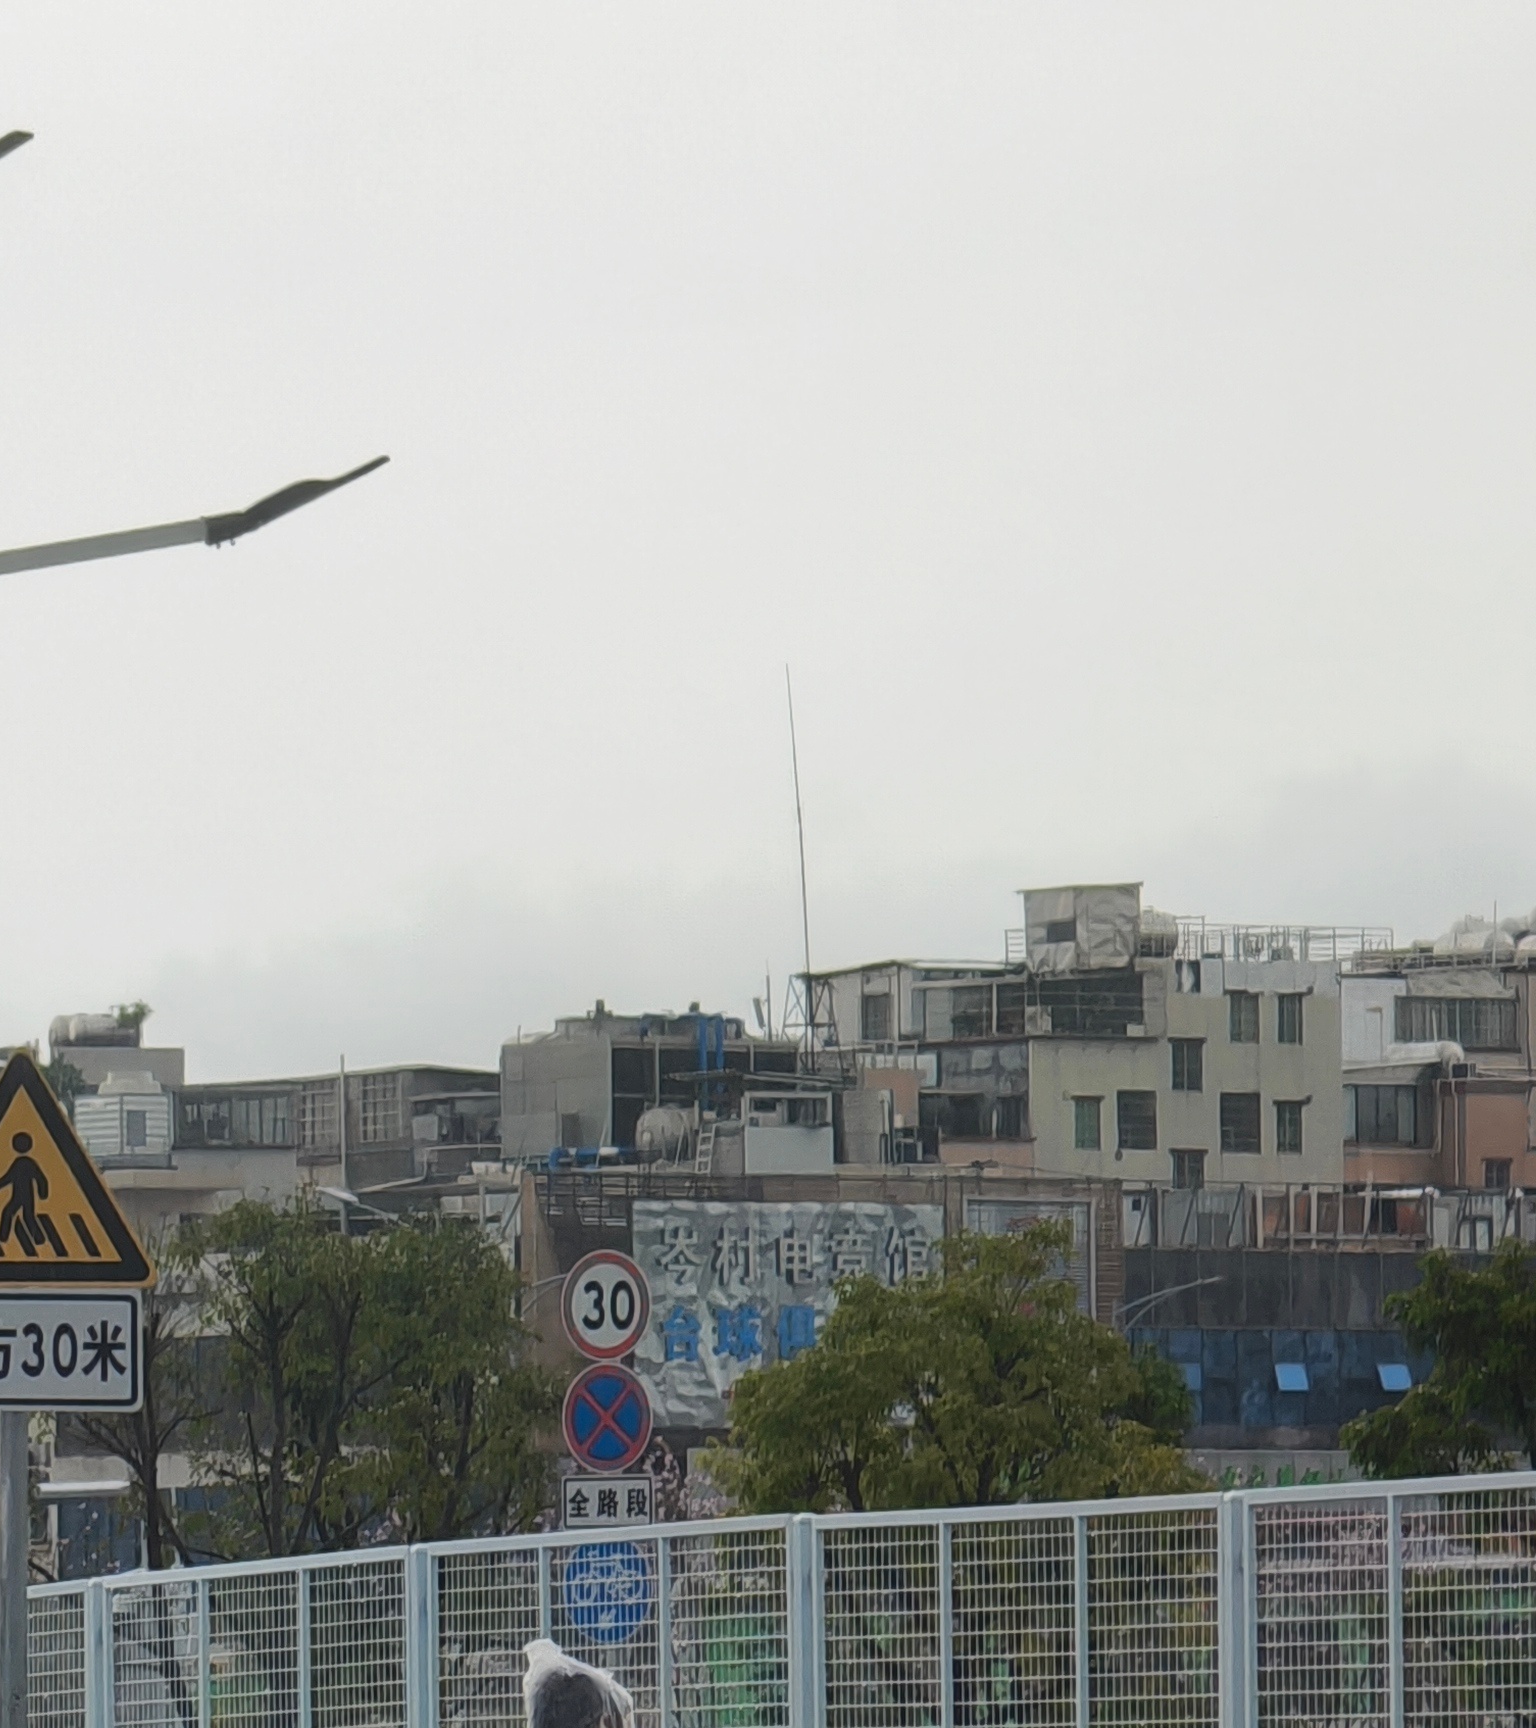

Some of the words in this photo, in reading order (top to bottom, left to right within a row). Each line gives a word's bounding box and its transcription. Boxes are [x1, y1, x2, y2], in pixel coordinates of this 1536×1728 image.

[656, 1226, 928, 1286] 岑村电竞馆
[582, 1280, 635, 1330] 30
[568, 1488, 648, 1518] 全路段
